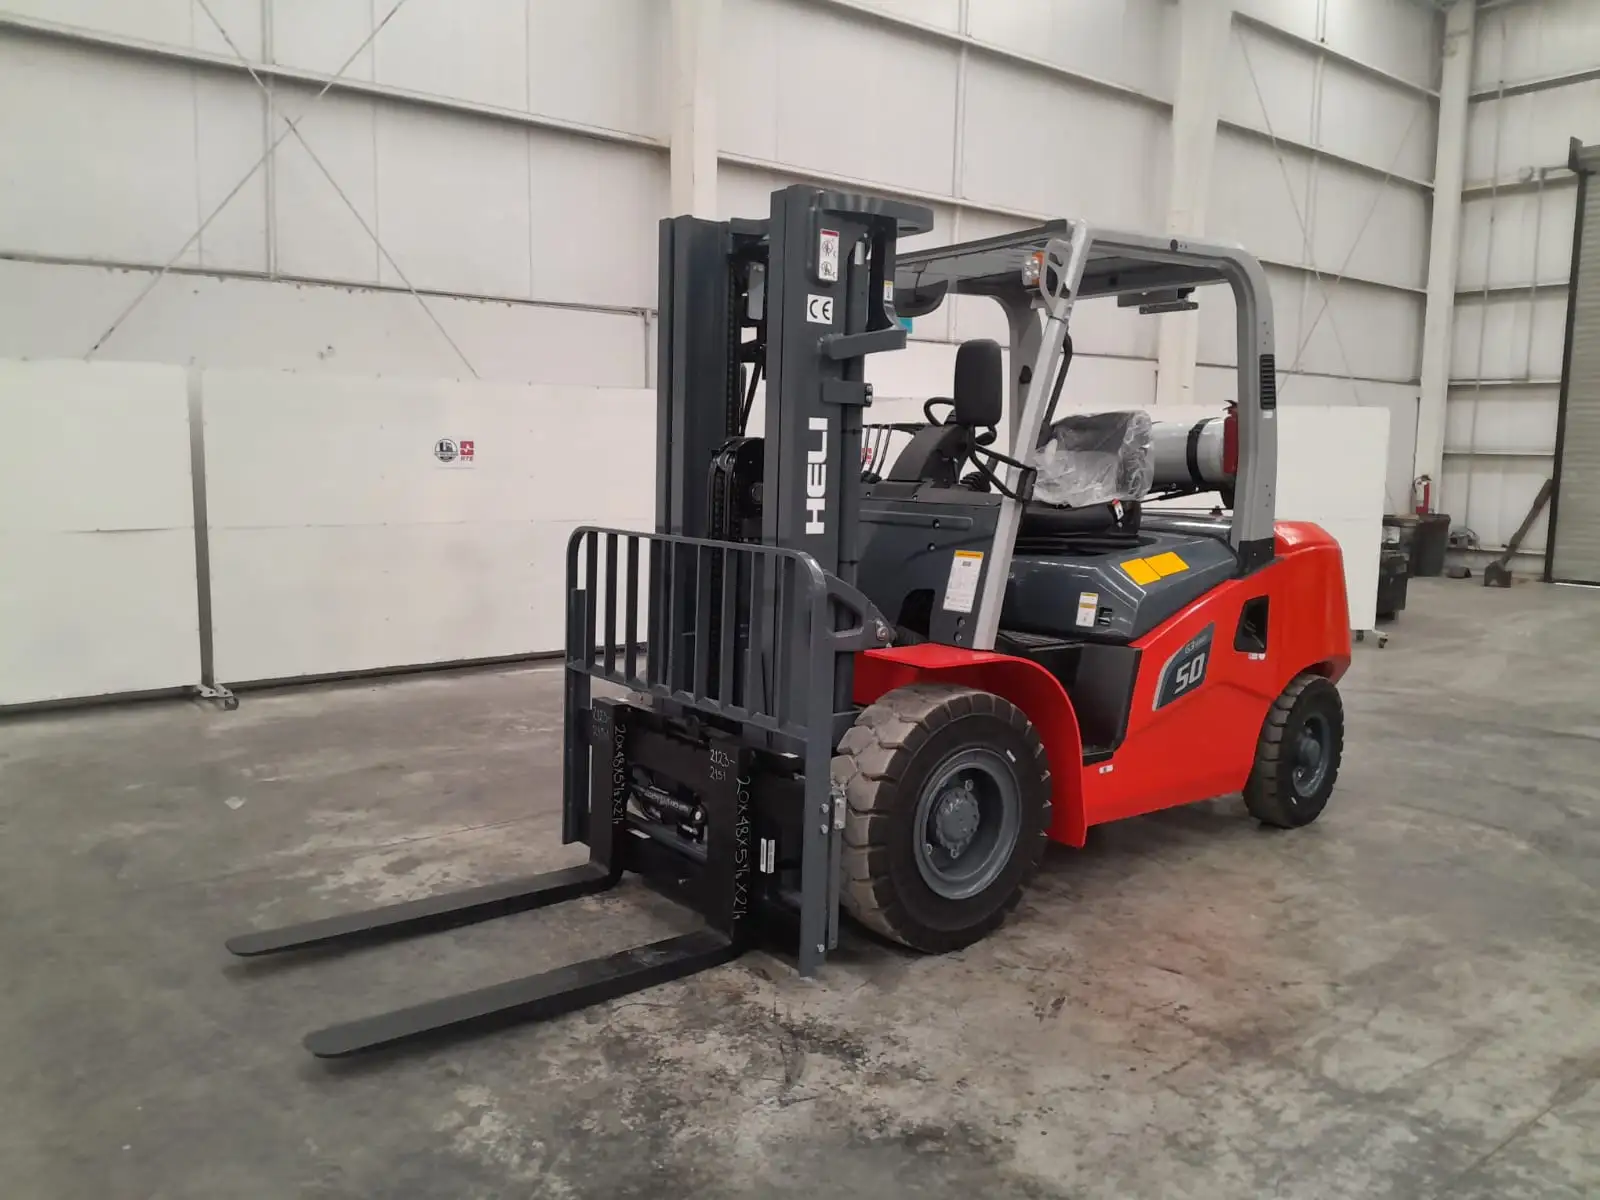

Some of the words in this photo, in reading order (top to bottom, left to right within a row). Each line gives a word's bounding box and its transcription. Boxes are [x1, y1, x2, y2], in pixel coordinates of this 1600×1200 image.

[809, 299, 831, 321] CE
[805, 417, 828, 534] HELI
[1174, 652, 1206, 695] 50
